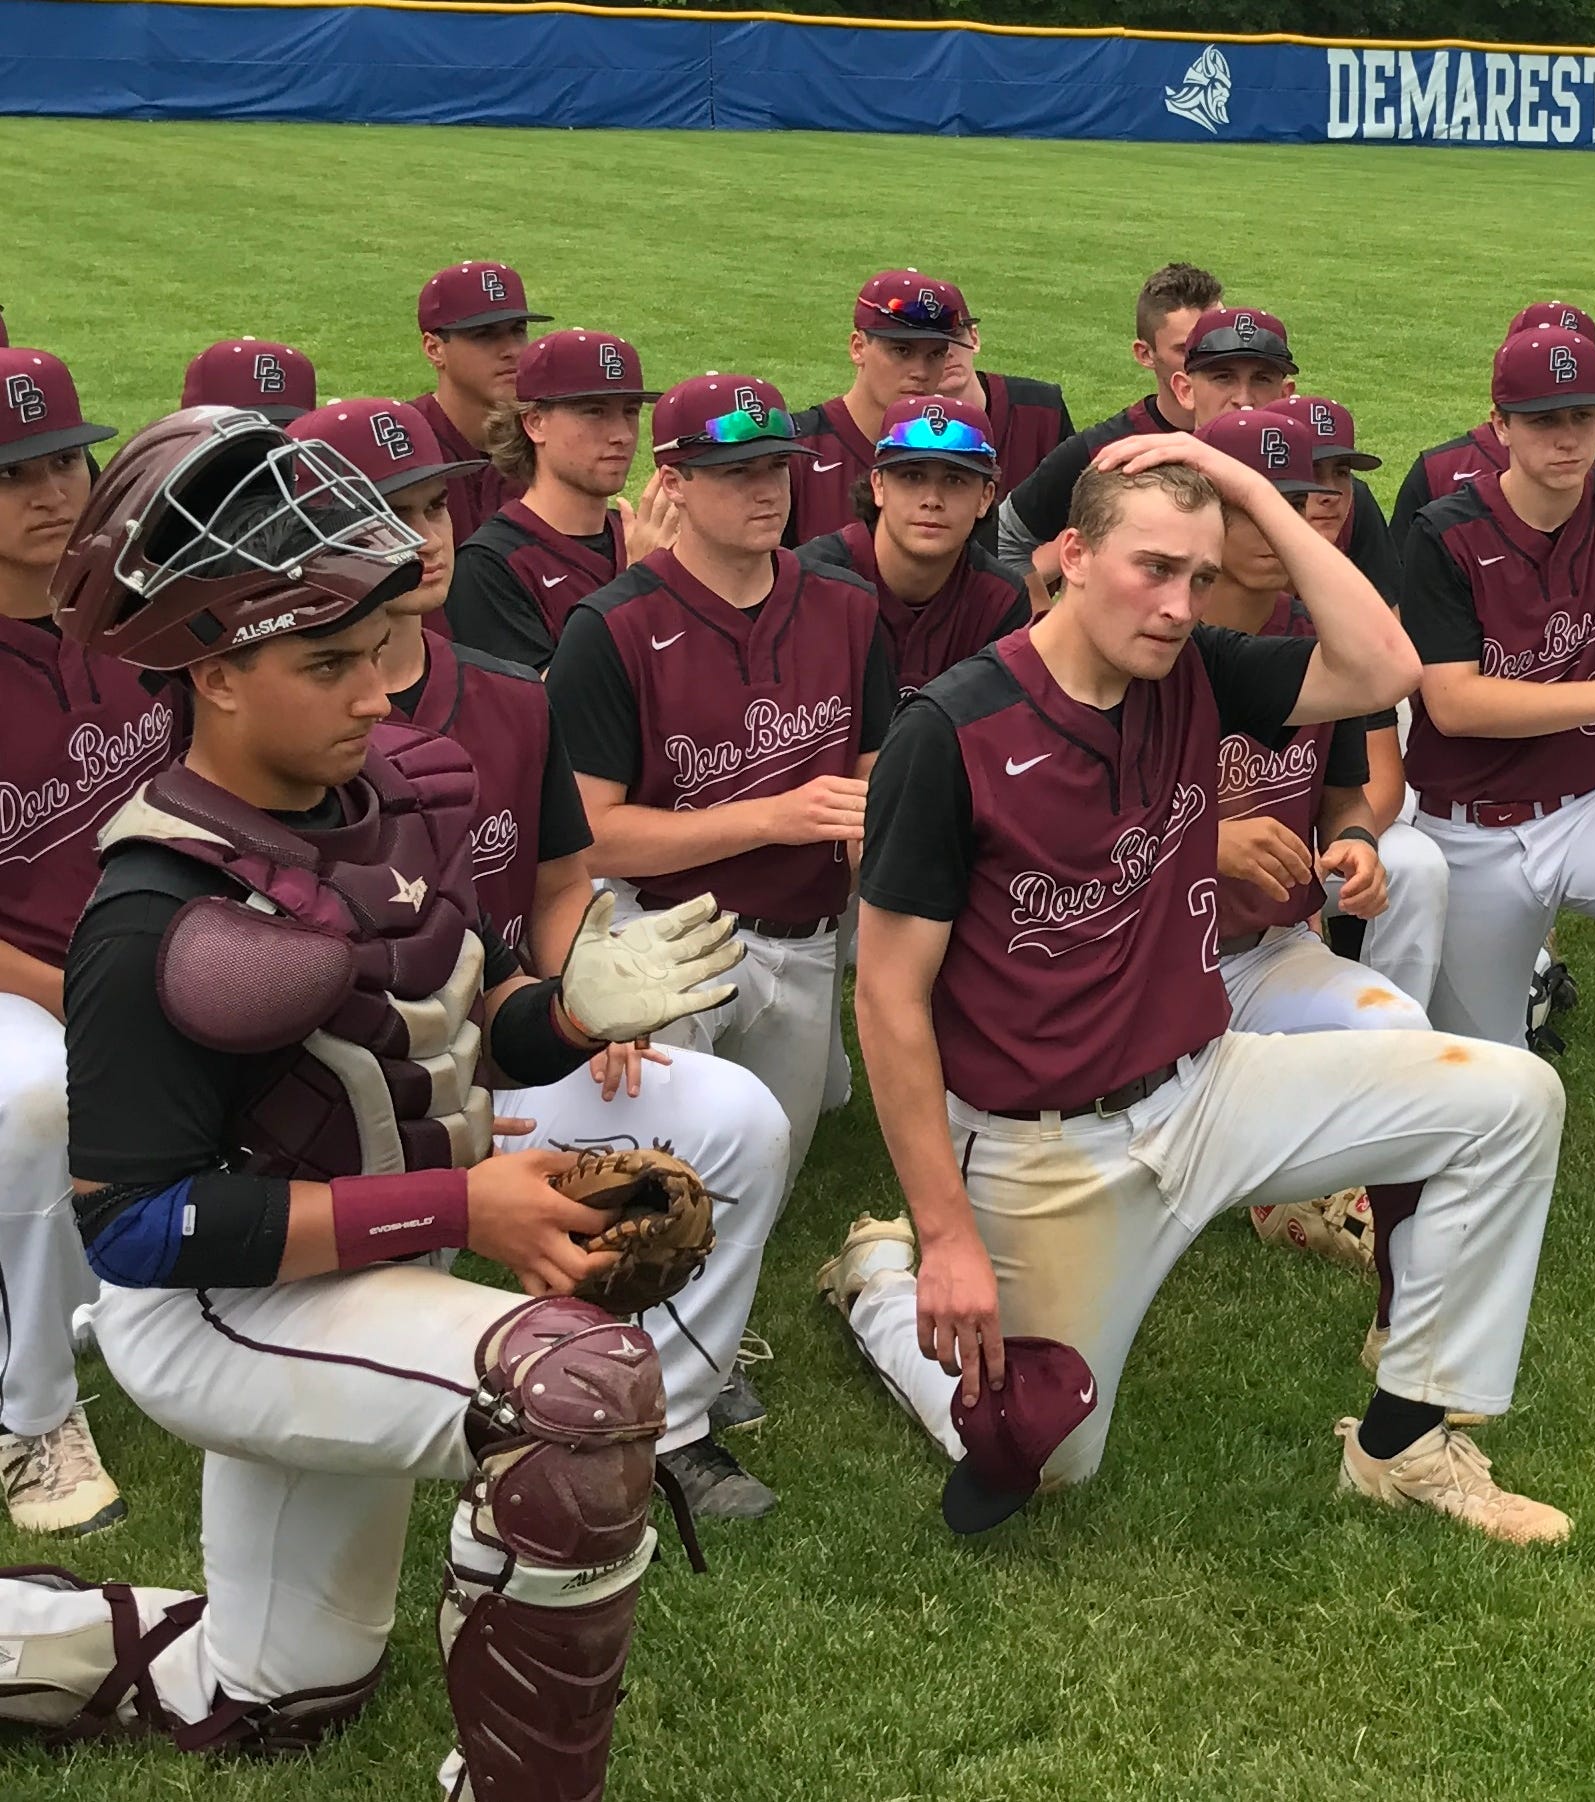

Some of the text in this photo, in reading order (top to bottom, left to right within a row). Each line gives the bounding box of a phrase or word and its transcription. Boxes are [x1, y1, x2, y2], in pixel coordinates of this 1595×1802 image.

[481, 270, 508, 301] DB
[254, 354, 286, 392] DB
[600, 343, 625, 379] DB
[1550, 346, 1577, 383] DB
[6, 373, 48, 423] DB
[370, 411, 414, 460] DB
[1311, 403, 1336, 436] DB
[1261, 427, 1290, 469] DB
[231, 612, 297, 644] ALL-STAR
[69, 702, 174, 792] Bosco
[665, 696, 851, 789] Don Bosco
[1217, 734, 1318, 796] Bosco
[1009, 871, 1106, 925] Don
